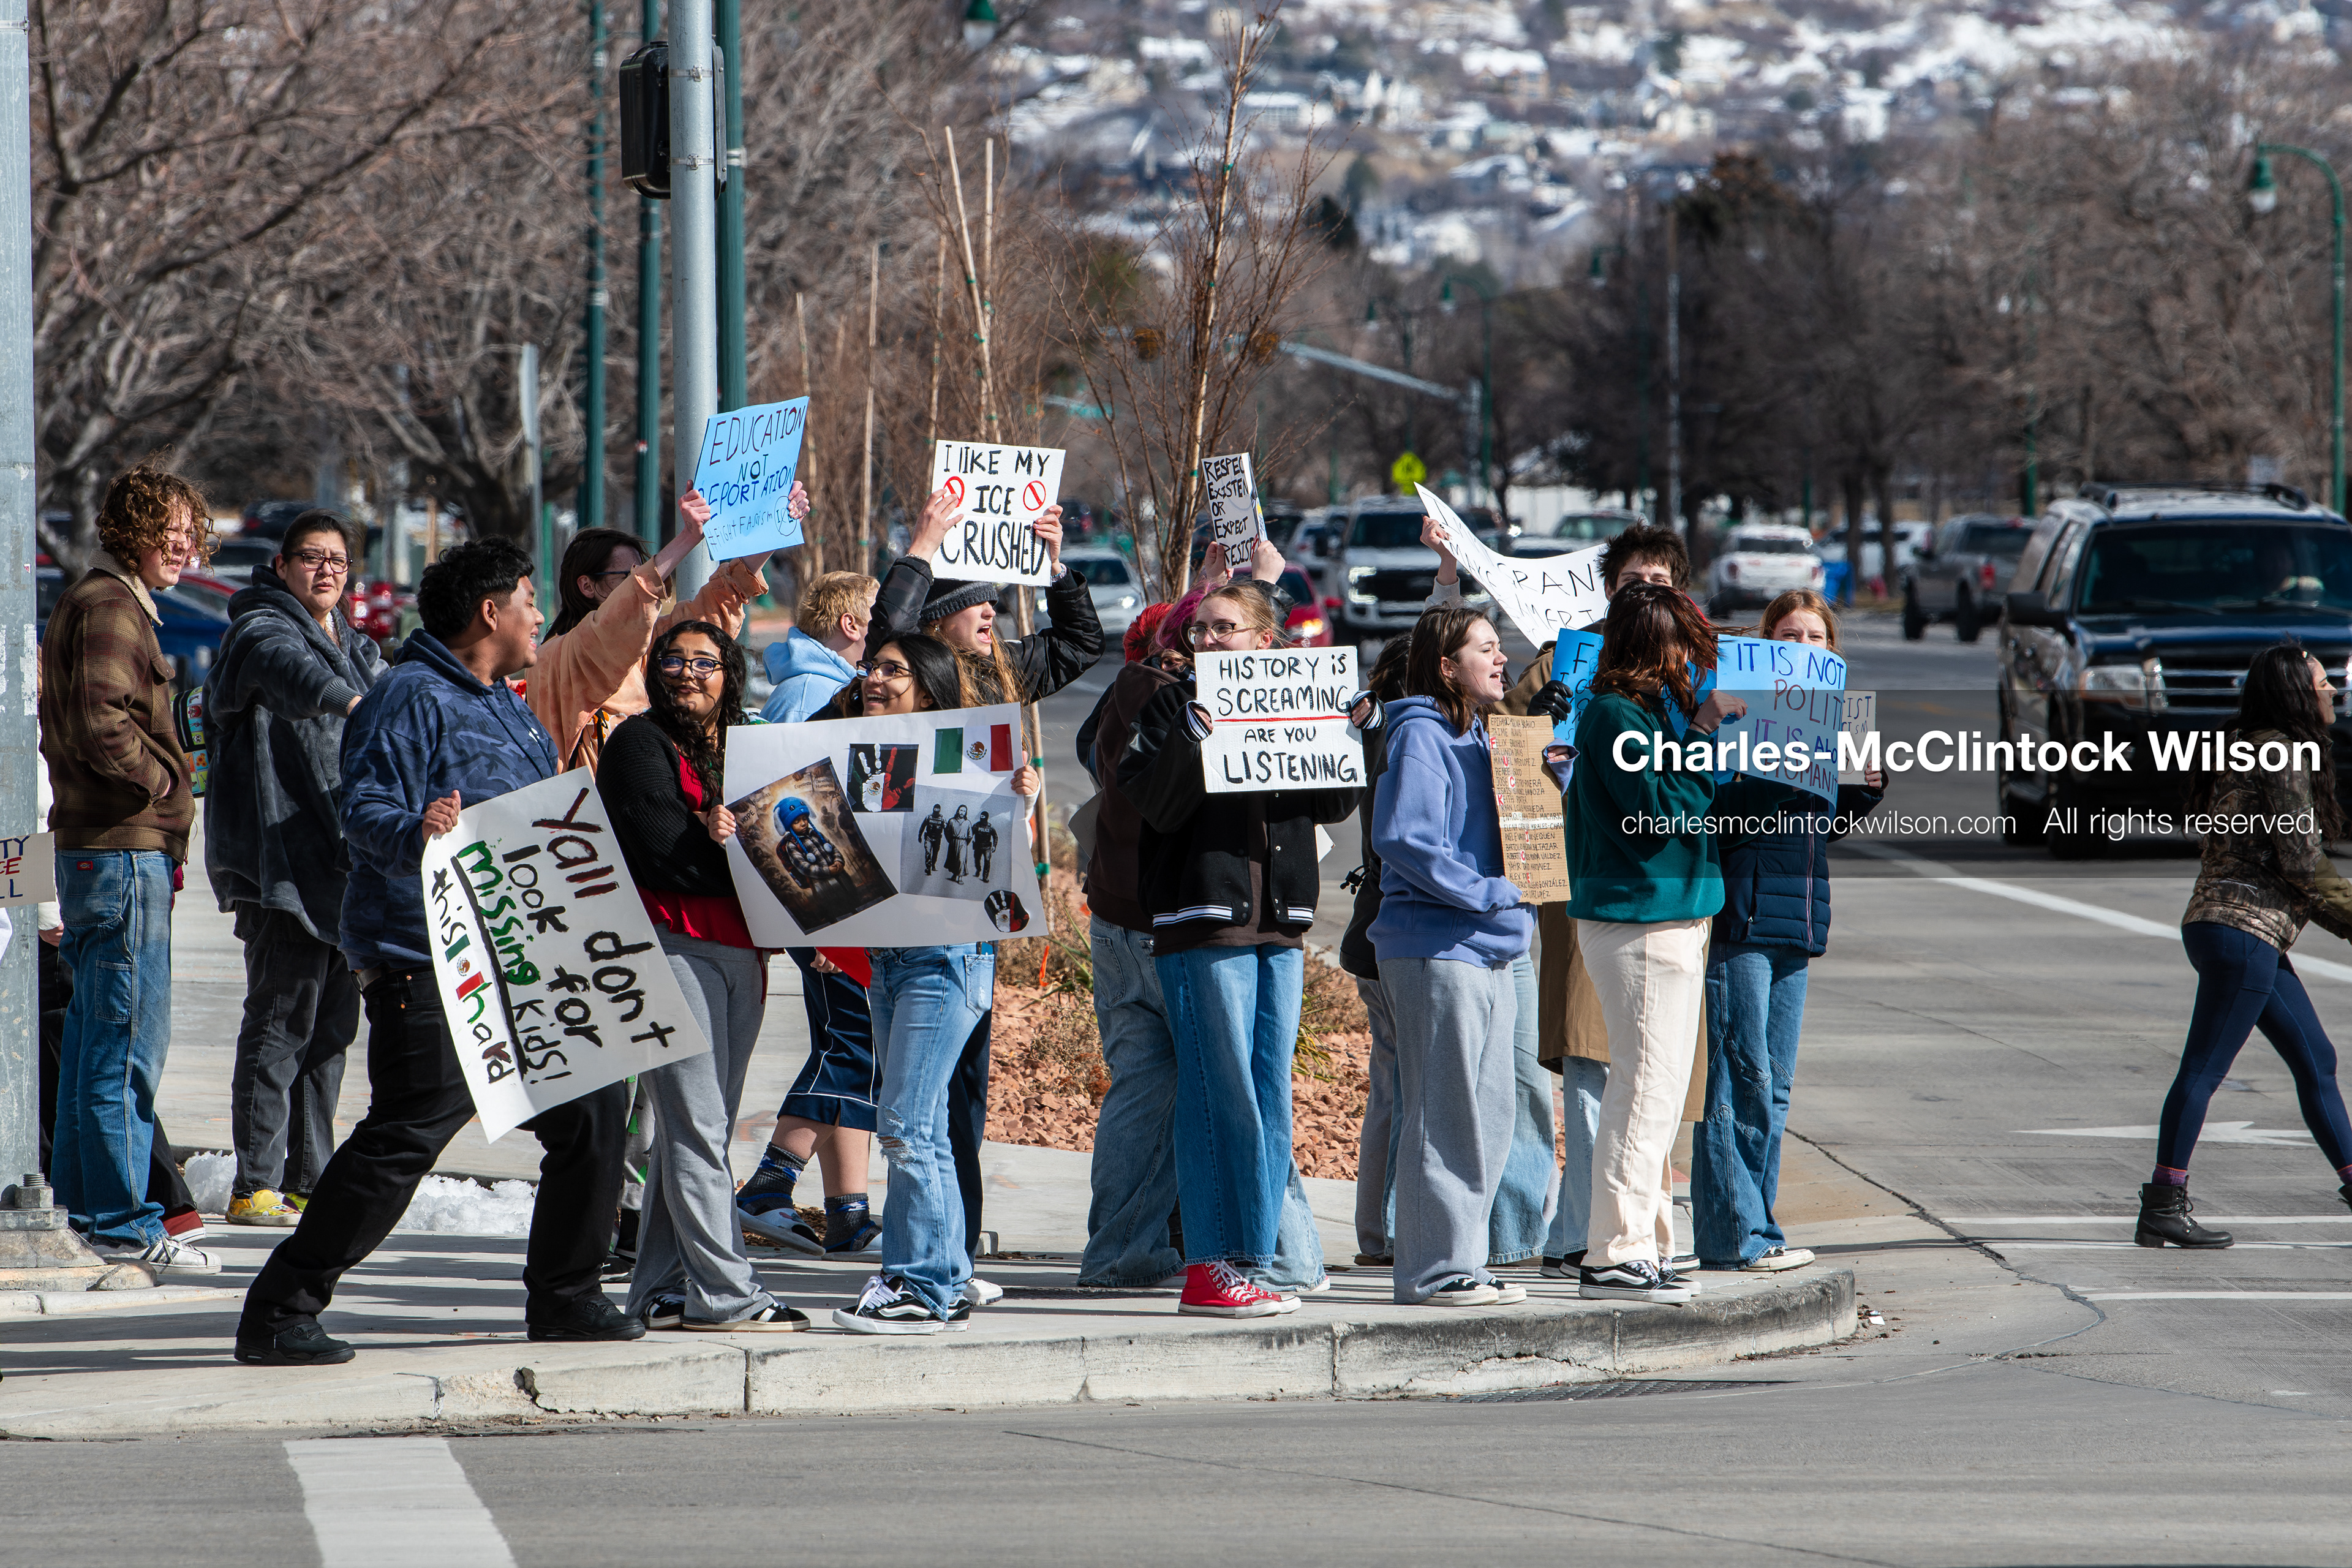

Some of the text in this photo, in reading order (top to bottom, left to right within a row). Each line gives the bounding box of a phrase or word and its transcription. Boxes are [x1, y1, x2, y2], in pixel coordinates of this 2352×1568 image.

[709, 405, 806, 467] EDUCATION
[737, 453, 769, 484] NOT
[943, 444, 952, 472] I
[1014, 449, 1050, 477] MY
[971, 484, 1016, 516] ICE
[1207, 477, 1249, 501] EXISTEN
[1212, 502, 1226, 517] OR
[1214, 516, 1248, 540] EXPECT
[940, 520, 1046, 576] CRUSHED
[1219, 655, 1319, 684] HISTORY
[1737, 643, 1844, 690] IT IS NOT
[1216, 685, 1351, 717] SCREAMING
[1244, 726, 1317, 744] ARE YOU
[1491, 728, 1509, 737] JAIME
[1223, 750, 1358, 784] LISTENING
[1497, 794, 1515, 806] KEITH
[739, 809, 756, 825] HOPE
[1509, 872, 1521, 881] ALEX
[456, 840, 541, 986] missing
[531, 787, 676, 1049] Yall dont
[502, 844, 603, 1049] look for
[462, 981, 516, 1084] hard
